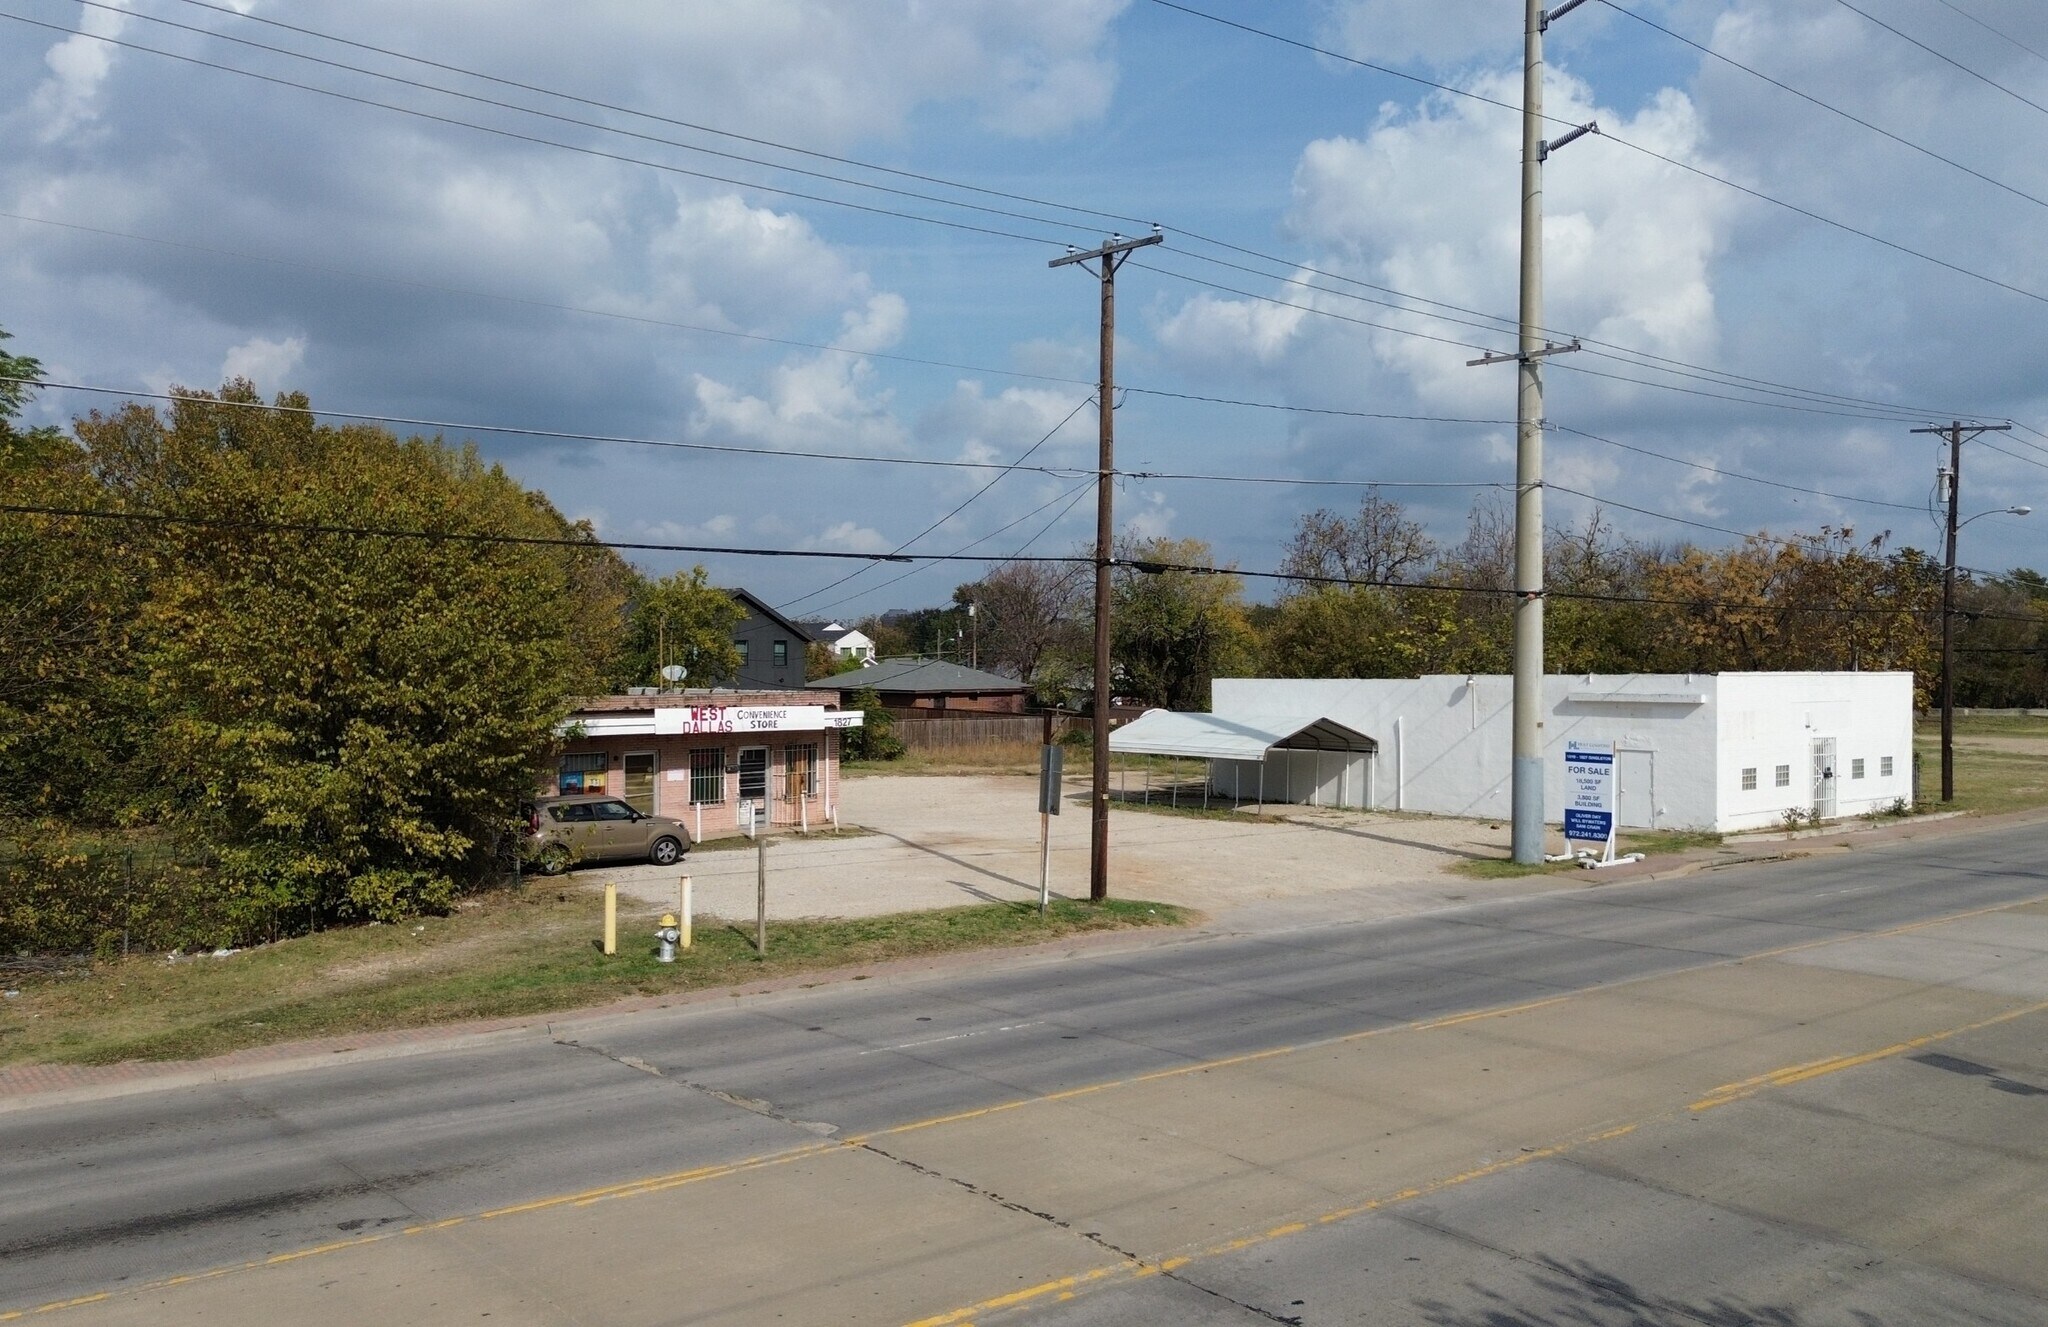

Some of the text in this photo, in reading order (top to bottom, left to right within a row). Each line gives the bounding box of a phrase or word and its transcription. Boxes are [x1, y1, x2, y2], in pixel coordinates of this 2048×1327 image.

[691, 706, 726, 721] WEST
[737, 710, 787, 720] CONVENIENCE
[683, 720, 733, 733] DALLAS
[750, 720, 778, 729] STORE
[834, 718, 852, 727] 1827
[1568, 766, 1610, 775] FOR SALE
[1568, 830, 1608, 839] 972.241.8300
